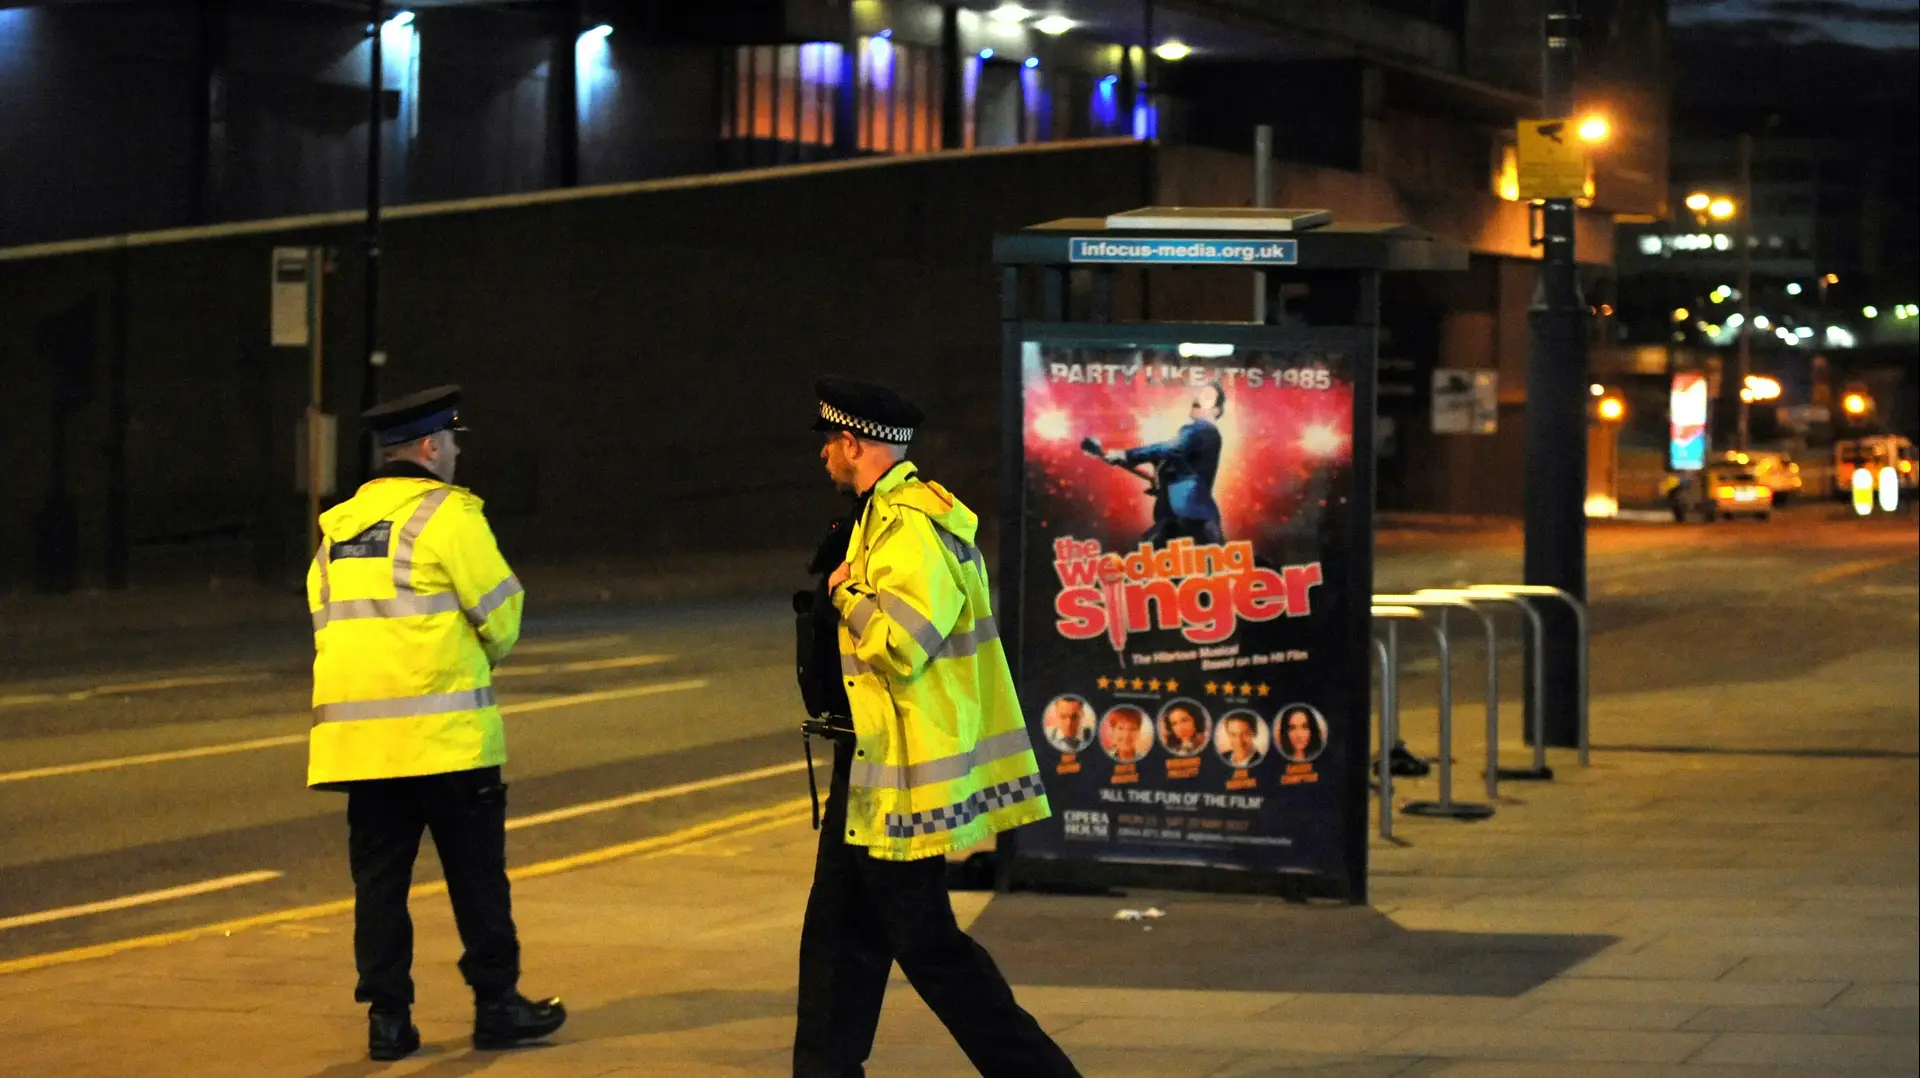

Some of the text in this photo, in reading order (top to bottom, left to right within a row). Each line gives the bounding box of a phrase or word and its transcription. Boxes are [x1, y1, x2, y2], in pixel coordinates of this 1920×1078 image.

[1081, 242, 1284, 260] infocus-media.org.uk
[1050, 363, 1138, 385] PARTY
[1146, 363, 1205, 387] LIKE
[1271, 368, 1331, 389] 1985
[1054, 536, 1101, 560] the
[1054, 537, 1253, 588] wedding
[1127, 790, 1152, 803] THE
[1154, 791, 1181, 805] FUN
[1183, 792, 1201, 806] OF
[1203, 793, 1227, 808] THE
